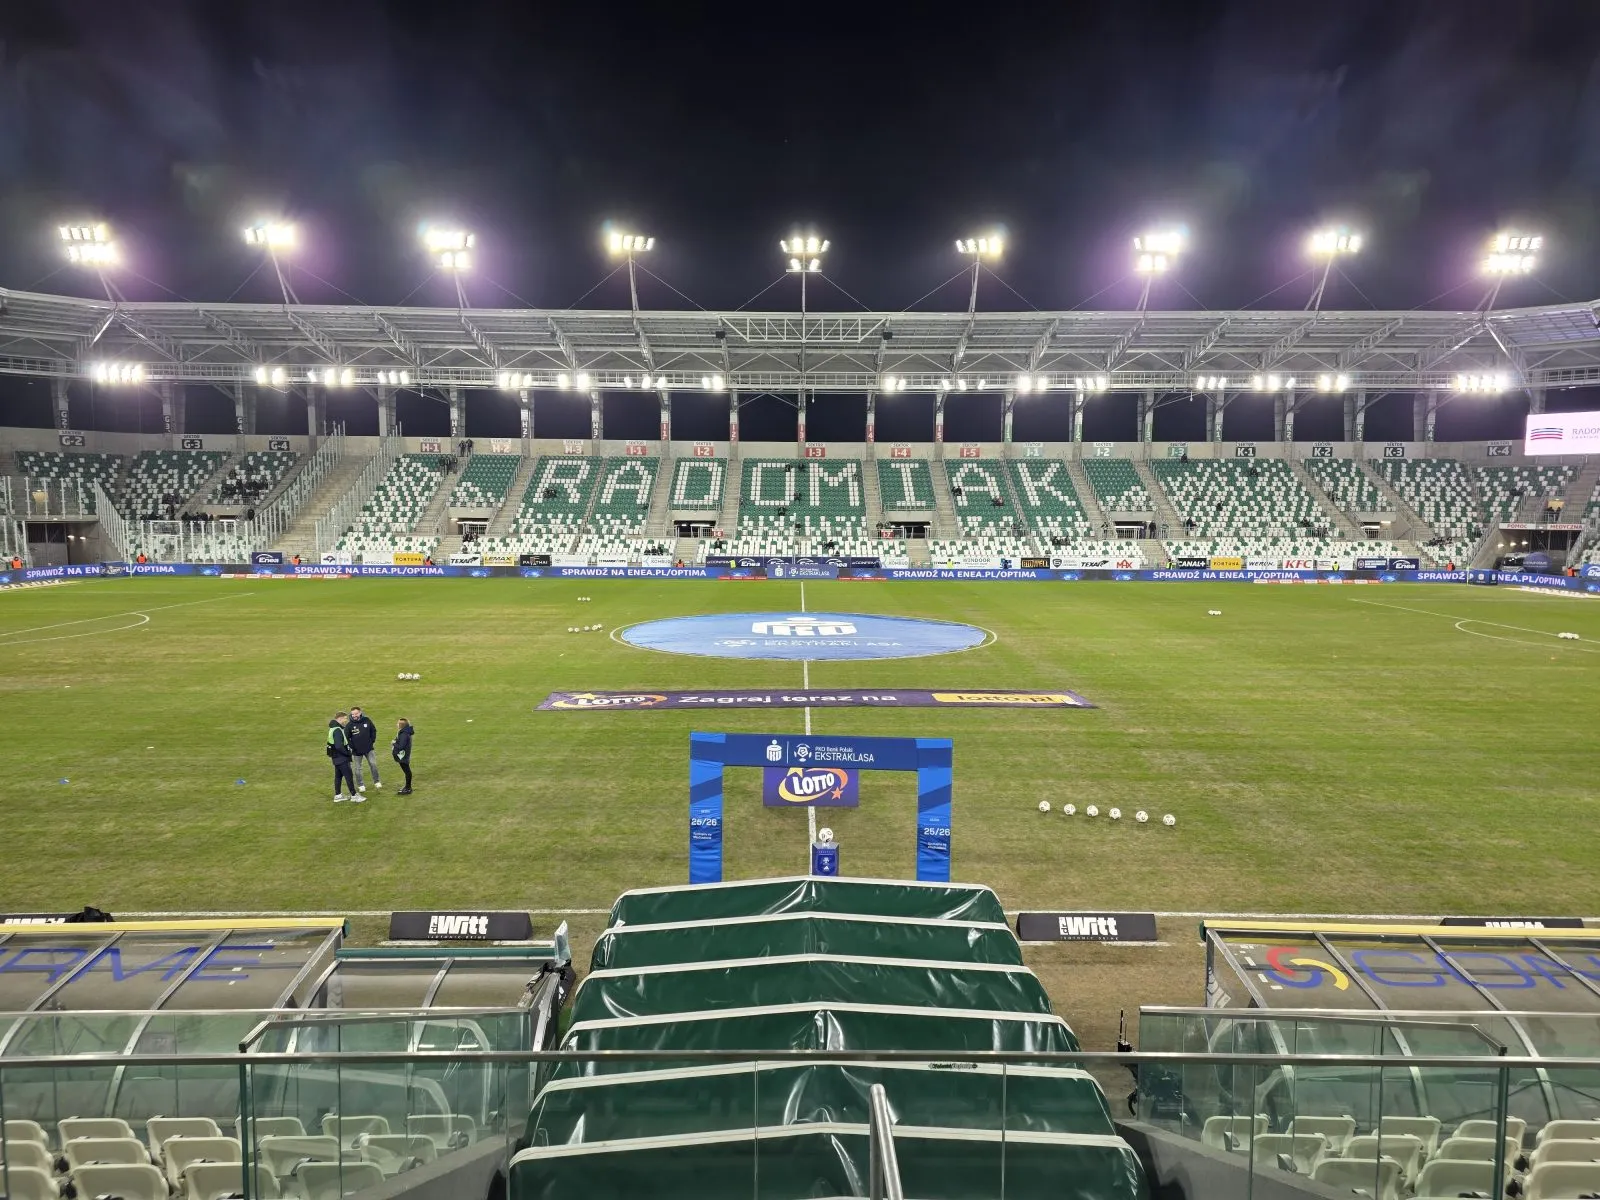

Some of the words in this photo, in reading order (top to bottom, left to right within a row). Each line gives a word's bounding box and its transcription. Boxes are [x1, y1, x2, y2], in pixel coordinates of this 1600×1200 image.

[258, 556, 279, 564] Enea
[1285, 560, 1312, 568] KFC
[26, 566, 64, 579] SPRAWDŹ
[67, 567, 82, 575] NA
[86, 565, 175, 575] ENL/OPTIMA
[294, 565, 343, 574] SPRAWDŹ
[362, 567, 444, 575] ENEA.PL/OPTIMA
[562, 567, 608, 576] SPRAWDŹ
[627, 569, 707, 577] ENEA.PL/OPTIMA
[892, 569, 938, 578] SPRAWDŹ
[957, 570, 1036, 579] ENEA.PL/OPTIMA
[1152, 570, 1200, 579] SPRAWDŹ
[1202, 571, 1217, 579] NA
[1219, 571, 1300, 580] ENEA.PL/OPTIMA
[1417, 571, 1465, 580] SPRAWDŹ
[1497, 574, 1566, 587] NEA.PL/OPTIMA
[957, 695, 1056, 703] lotto.pl
[814, 752, 875, 763] EKSTRAKLASA
[793, 773, 835, 795] LOTTO
[691, 817, 717, 826] 25/26
[923, 827, 951, 836] 25/26
[437, 915, 489, 934] Witt
[1065, 916, 1119, 935] Witt
